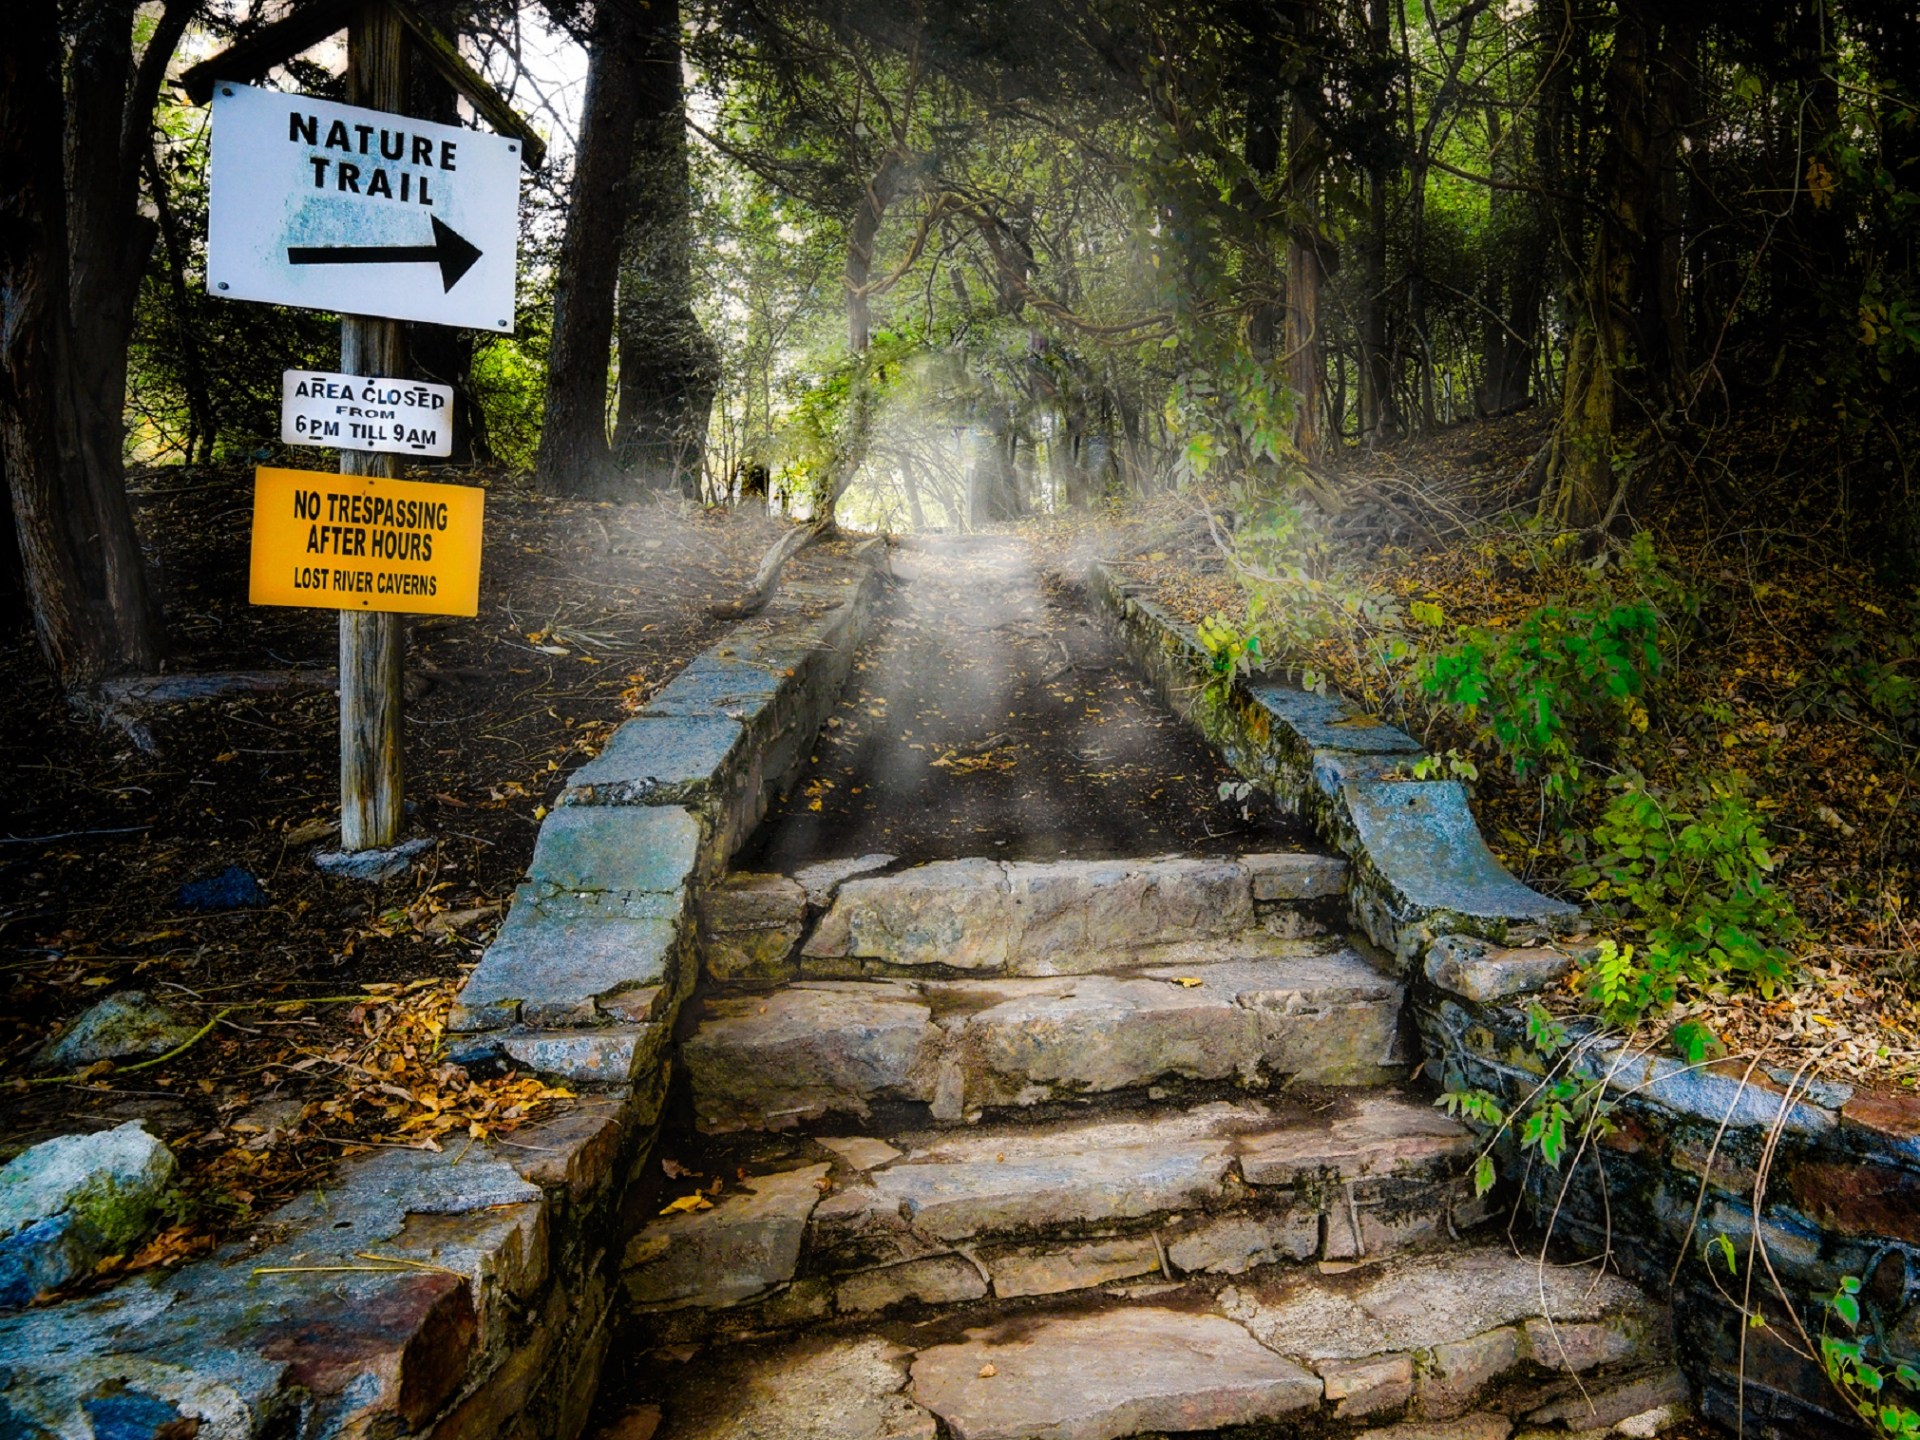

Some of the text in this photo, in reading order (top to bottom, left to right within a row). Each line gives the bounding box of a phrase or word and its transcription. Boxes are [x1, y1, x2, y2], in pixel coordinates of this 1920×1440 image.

[289, 112, 457, 171] NATURE
[310, 157, 433, 205] TRAIL
[295, 381, 445, 410] AREA CLOSED
[336, 406, 395, 419] FROM
[295, 415, 436, 445] 6PM TILL 9AM
[294, 490, 447, 531] NO TRESPASSING
[306, 525, 432, 562] AFTER HOURS
[294, 567, 437, 596] LOST RIVER CAVERNS
